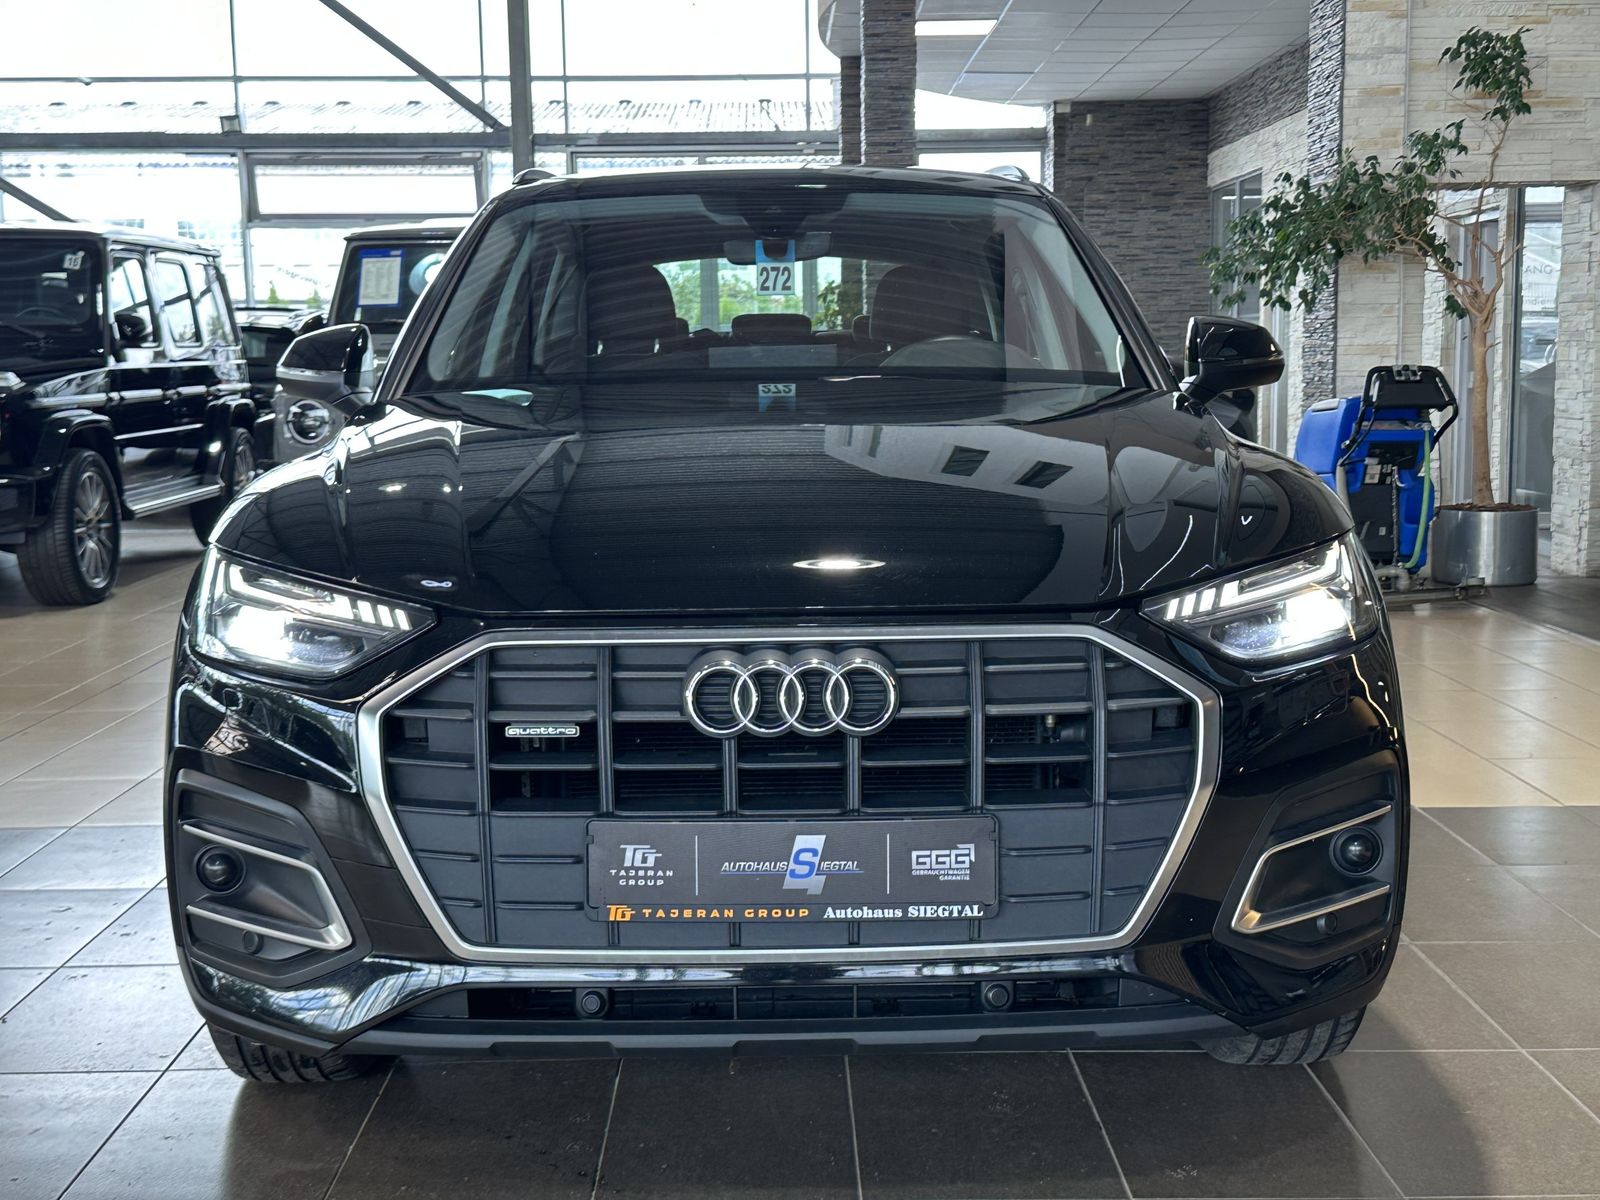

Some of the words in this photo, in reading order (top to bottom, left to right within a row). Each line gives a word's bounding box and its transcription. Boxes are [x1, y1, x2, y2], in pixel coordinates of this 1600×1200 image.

[760, 266, 792, 292] 272
[508, 727, 576, 736] quattro
[620, 844, 662, 867] TG
[911, 848, 970, 869] GGG
[609, 869, 673, 877] TAJERAN
[721, 861, 788, 872] AUTOHAUS
[606, 904, 636, 921] TG
[642, 908, 734, 918] TAJERAN
[744, 908, 809, 918] GROUP
[823, 906, 903, 919] Autohaus
[907, 904, 984, 917] SIEGTAL
